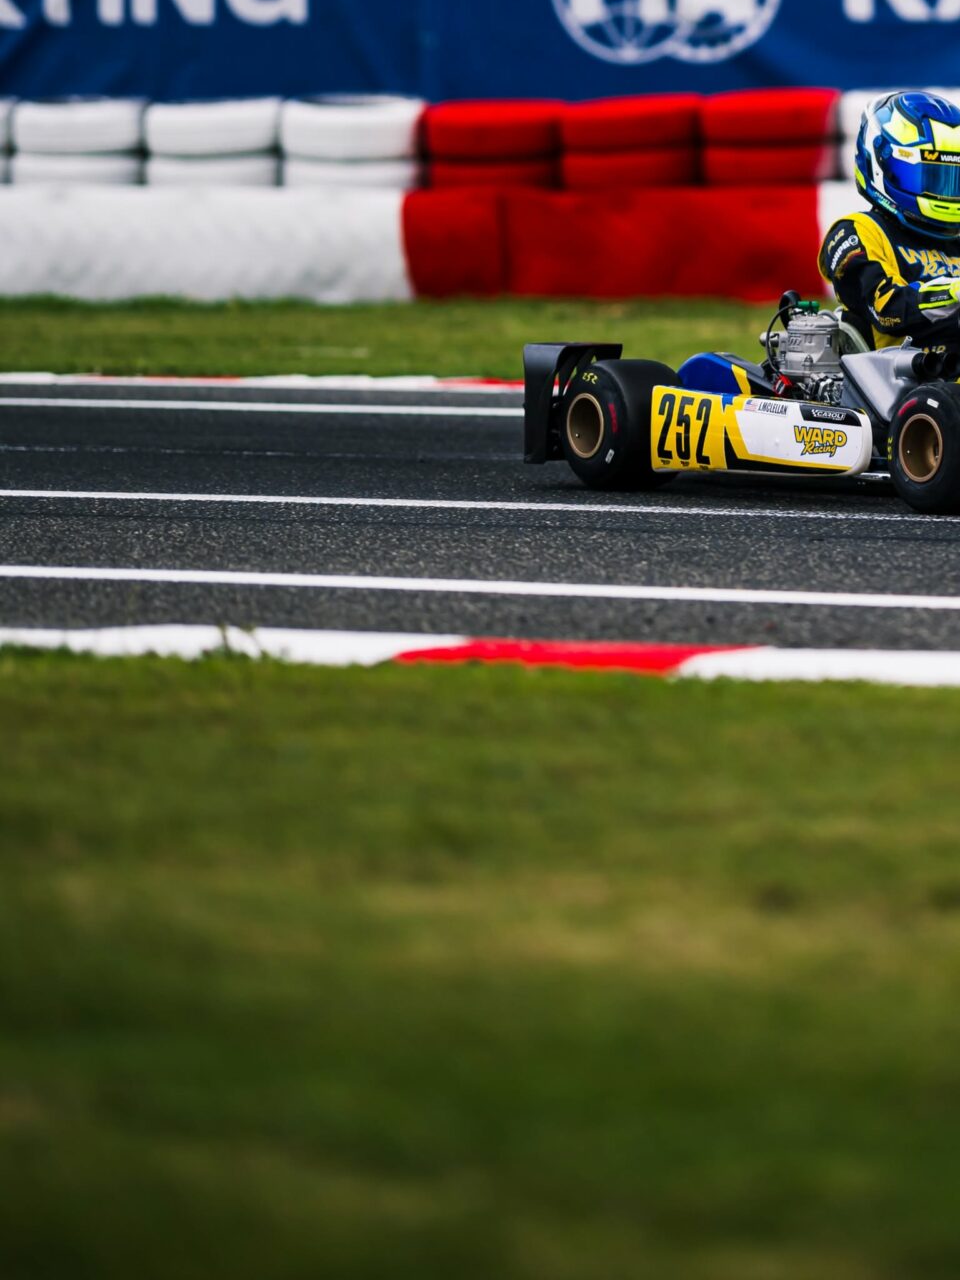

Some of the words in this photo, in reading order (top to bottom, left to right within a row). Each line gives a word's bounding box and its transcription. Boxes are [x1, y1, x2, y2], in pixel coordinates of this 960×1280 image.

[656, 392, 712, 466] 252
[793, 425, 848, 448] WARD
[800, 441, 837, 458] Racing
